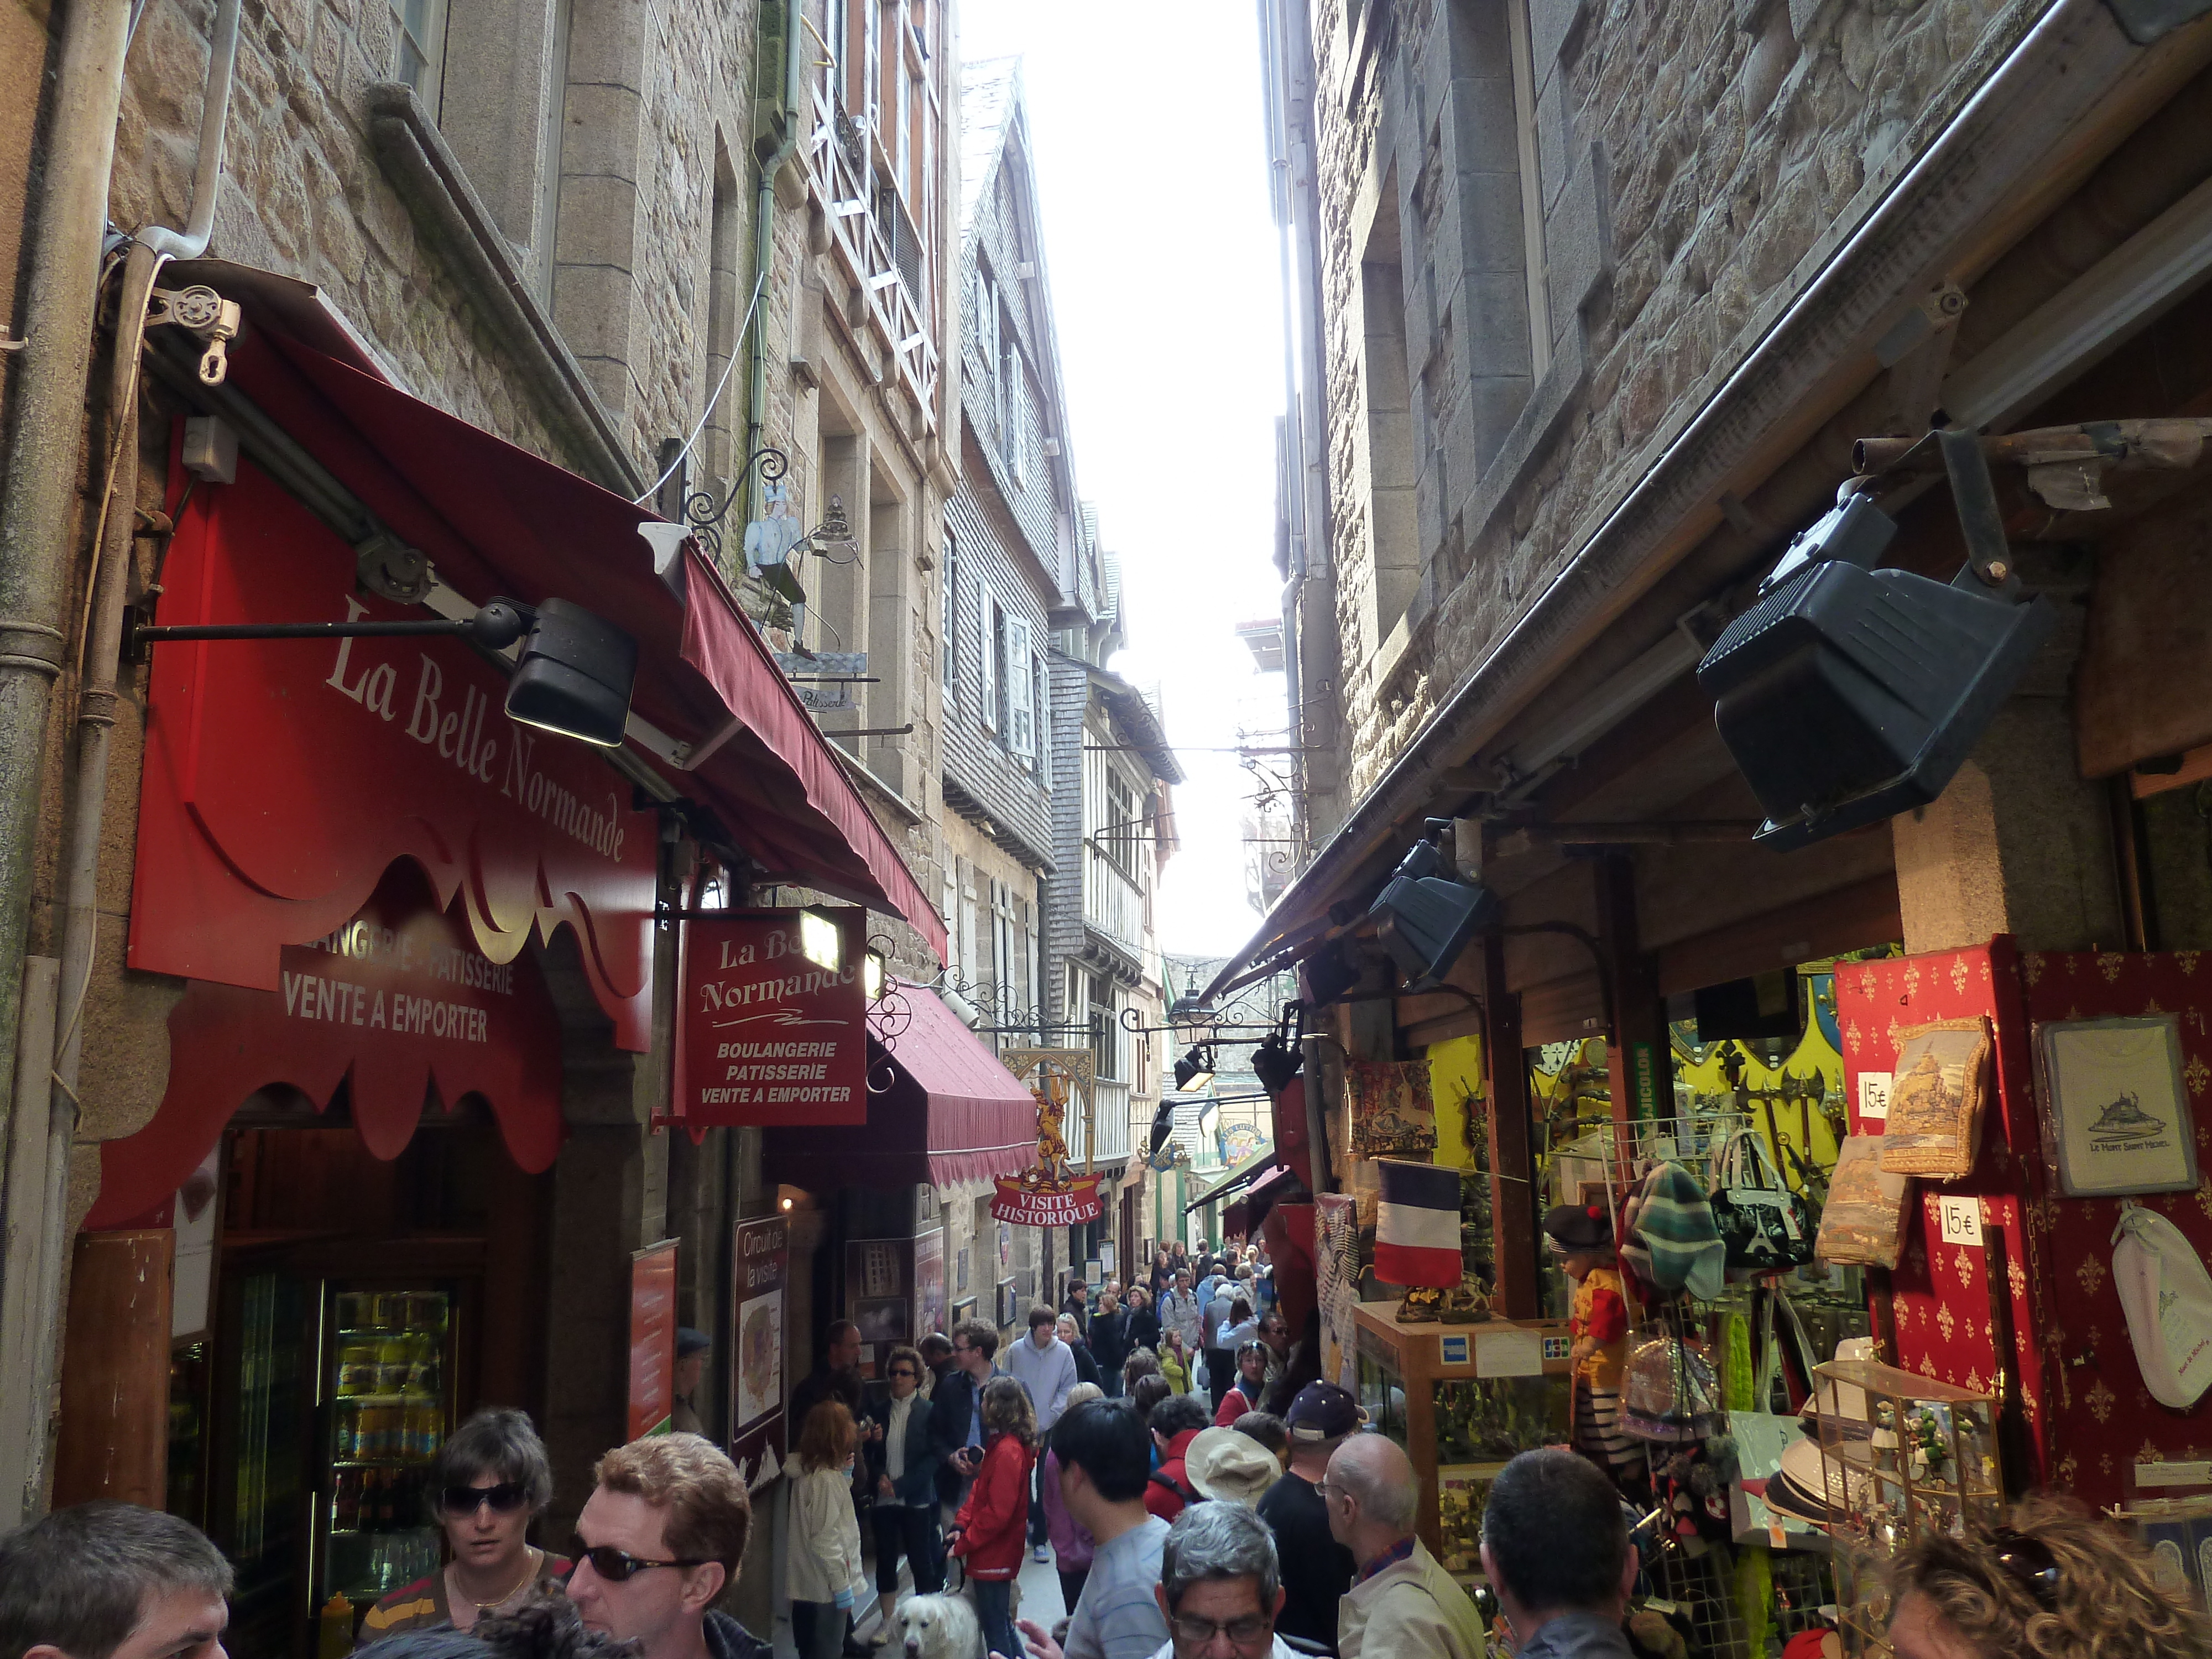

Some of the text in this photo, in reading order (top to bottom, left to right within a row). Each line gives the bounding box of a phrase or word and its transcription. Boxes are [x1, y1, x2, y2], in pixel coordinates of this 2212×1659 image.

[326, 594, 624, 862] La Belle Normande
[718, 940, 756, 970] La
[701, 964, 855, 1013] Normande
[283, 970, 487, 1042] VENTE A EMPORTER
[717, 1042, 837, 1058] BOULANGERIE
[726, 1064, 827, 1081] PATISSERIE
[702, 1087, 851, 1103] VENTE A EMPORTER
[1864, 1081, 1887, 1108] 15€
[996, 1202, 1099, 1225] HISTORIQUE
[1020, 1193, 1076, 1210] VISITE
[1945, 1203, 1975, 1235] 15€
[744, 1228, 772, 1256] Circuit
[747, 1259, 778, 1288] la visite
